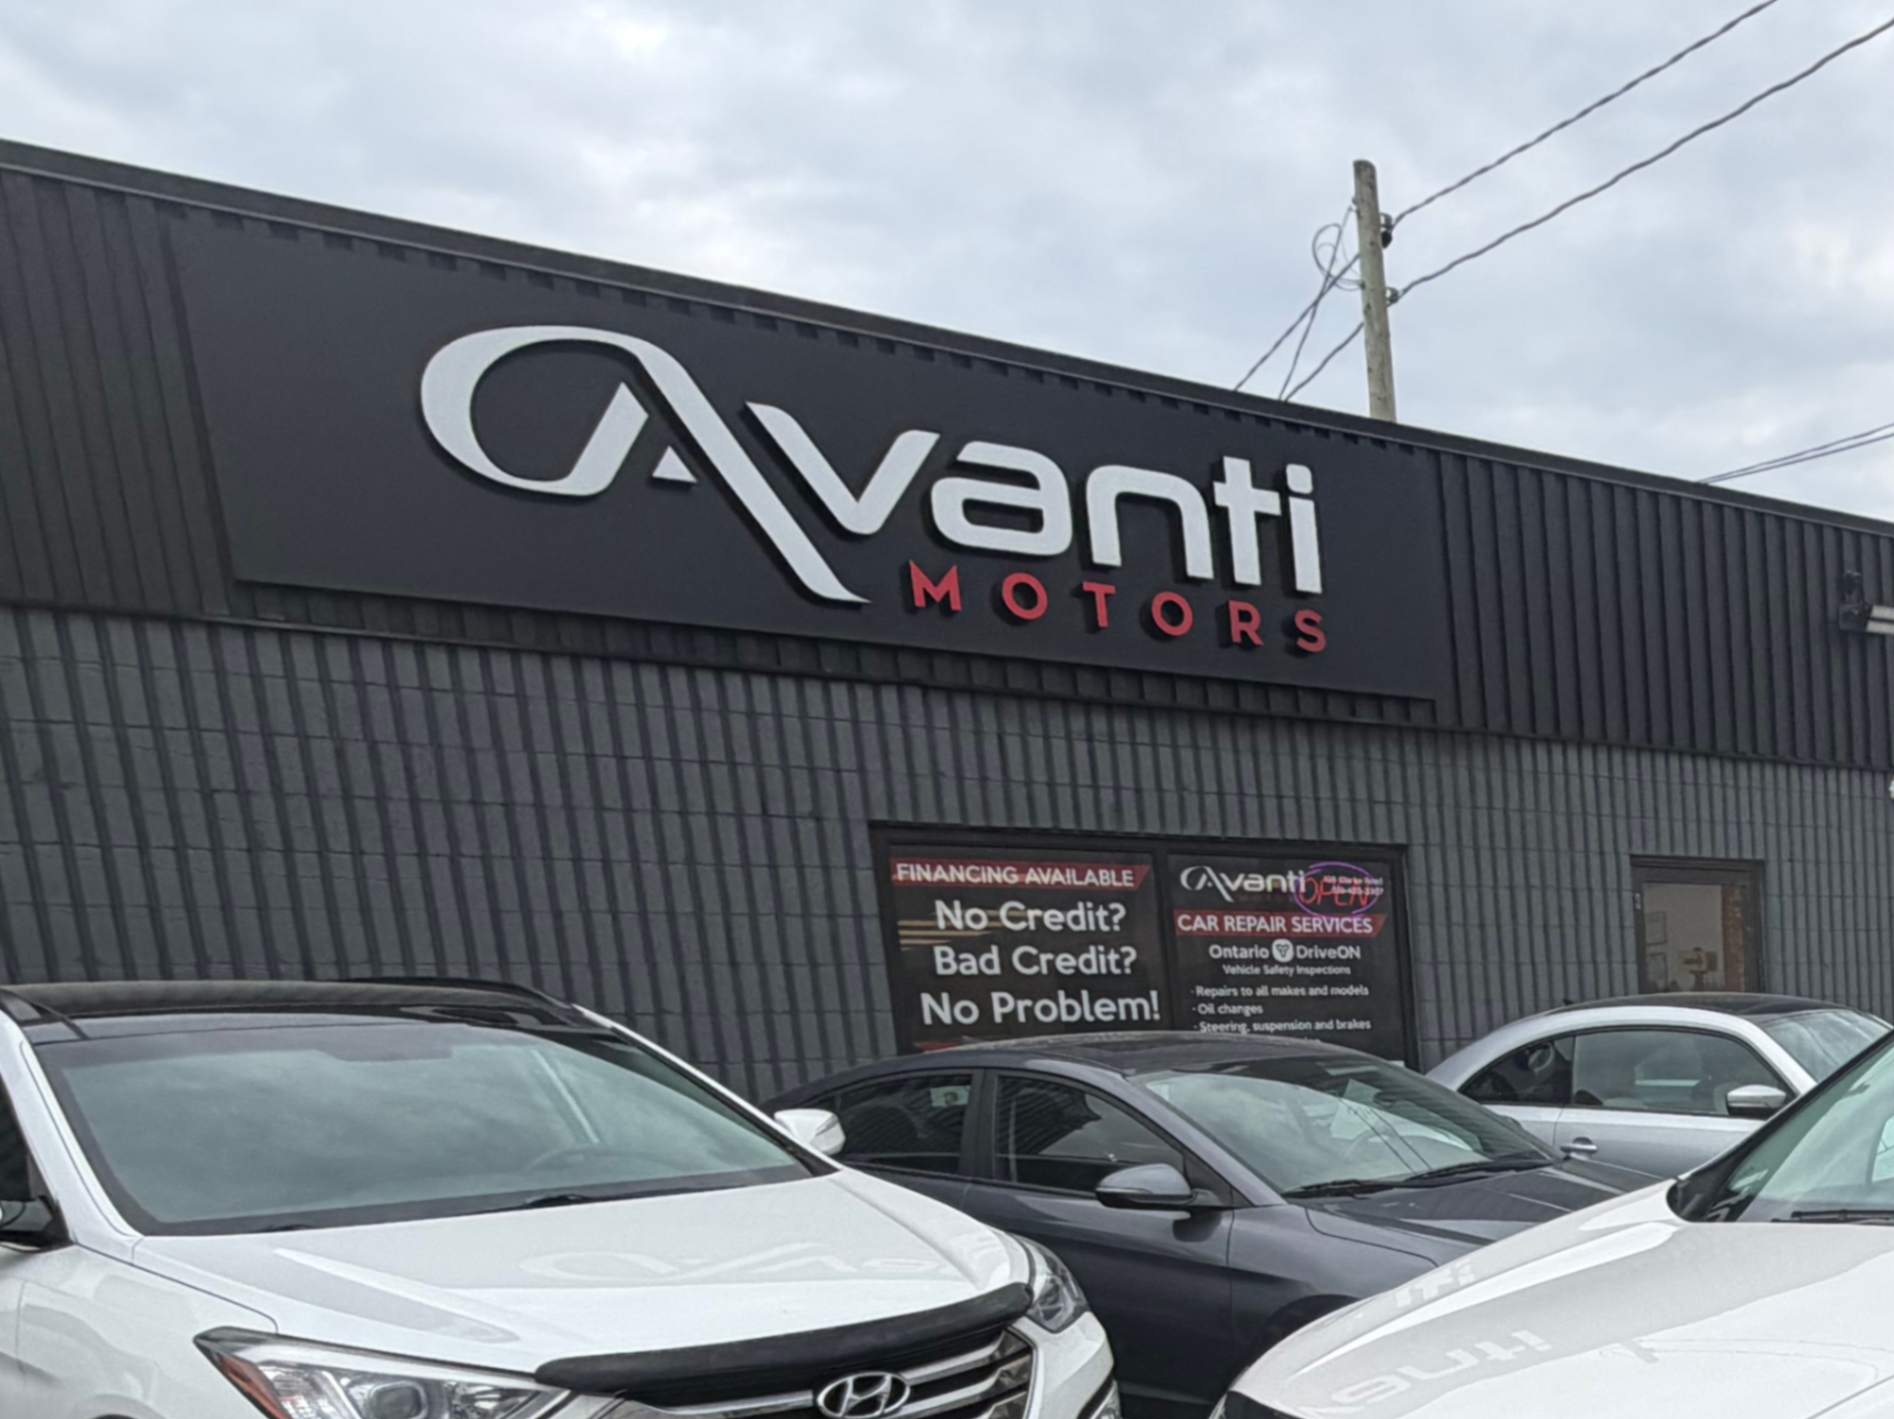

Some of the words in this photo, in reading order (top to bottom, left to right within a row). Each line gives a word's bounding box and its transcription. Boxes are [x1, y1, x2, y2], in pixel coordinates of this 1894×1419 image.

[420, 325, 1323, 604] Avanti
[908, 559, 1327, 653] MOTORS
[896, 863, 1018, 885] FINANCING
[1025, 867, 1134, 887] AVAILABLE
[934, 899, 988, 931] No
[1000, 901, 1126, 931] Credit?
[1177, 914, 1219, 932] CAR
[1224, 915, 1286, 932] REPAIR
[1292, 916, 1373, 934] SERVICES
[933, 945, 1001, 976] Bad
[1012, 945, 1137, 975] Credit?
[1209, 944, 1269, 959] Ontario
[1296, 945, 1361, 960] DriveON
[1222, 964, 1260, 975] Vehicle
[1263, 964, 1294, 977] Safety
[1296, 965, 1351, 977] Inspections
[1240, 986, 1253, 996] to
[1255, 985, 1269, 996] all
[1271, 985, 1306, 996] makes
[1308, 985, 1328, 996] and
[1330, 985, 1370, 996] models
[920, 992, 979, 1026] No
[991, 990, 1160, 1024] Problem!
[1218, 1003, 1263, 1016] changes
[1253, 1020, 1312, 1032] suspension
[1314, 1020, 1334, 1031] and
[1336, 1019, 1372, 1030] brakes
